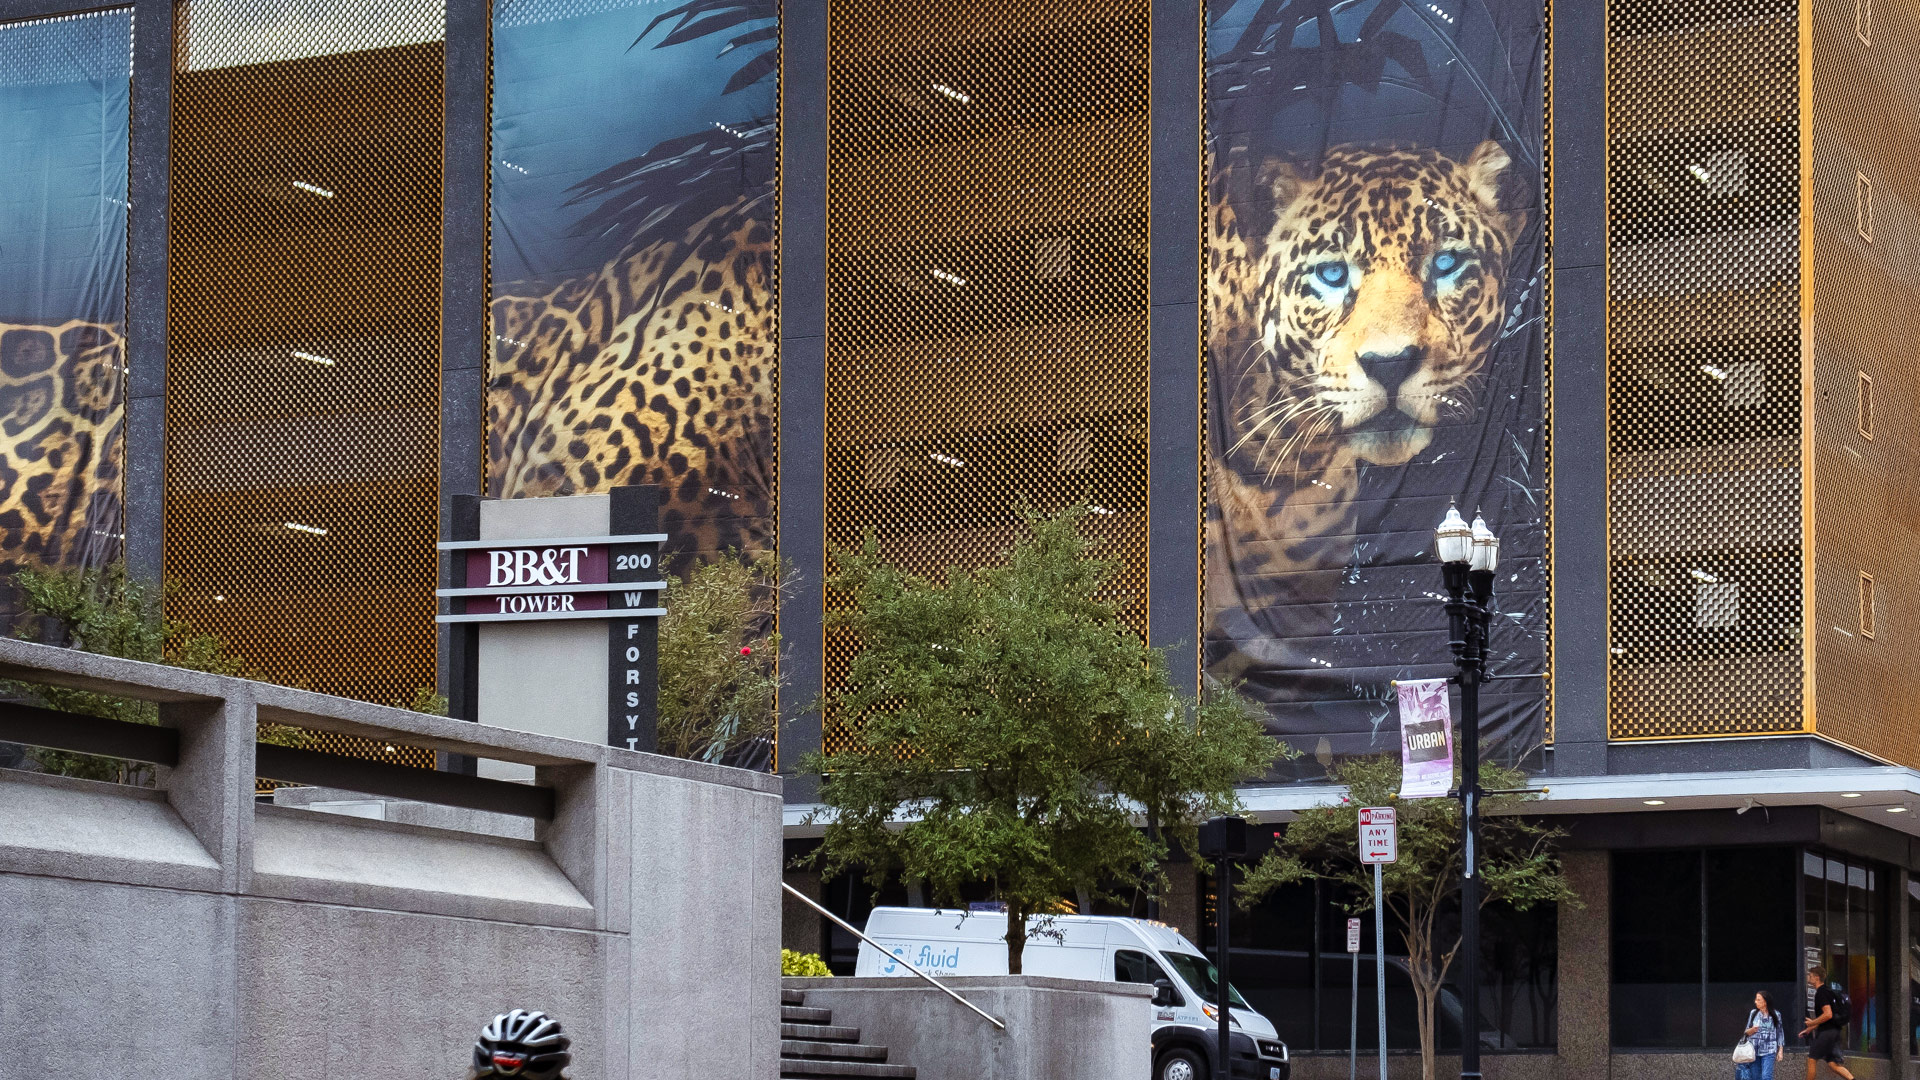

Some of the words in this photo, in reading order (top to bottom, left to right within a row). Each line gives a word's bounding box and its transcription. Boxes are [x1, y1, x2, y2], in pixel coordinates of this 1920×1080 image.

[486, 547, 589, 587] BB&T
[616, 554, 652, 571] 200
[496, 594, 576, 614] TOWER
[624, 592, 642, 607] W
[1408, 730, 1446, 751] URBAN
[1360, 811, 1371, 823] NO
[1368, 828, 1388, 837] ANY
[1368, 839, 1389, 847] TIME
[914, 944, 960, 969] fluid
